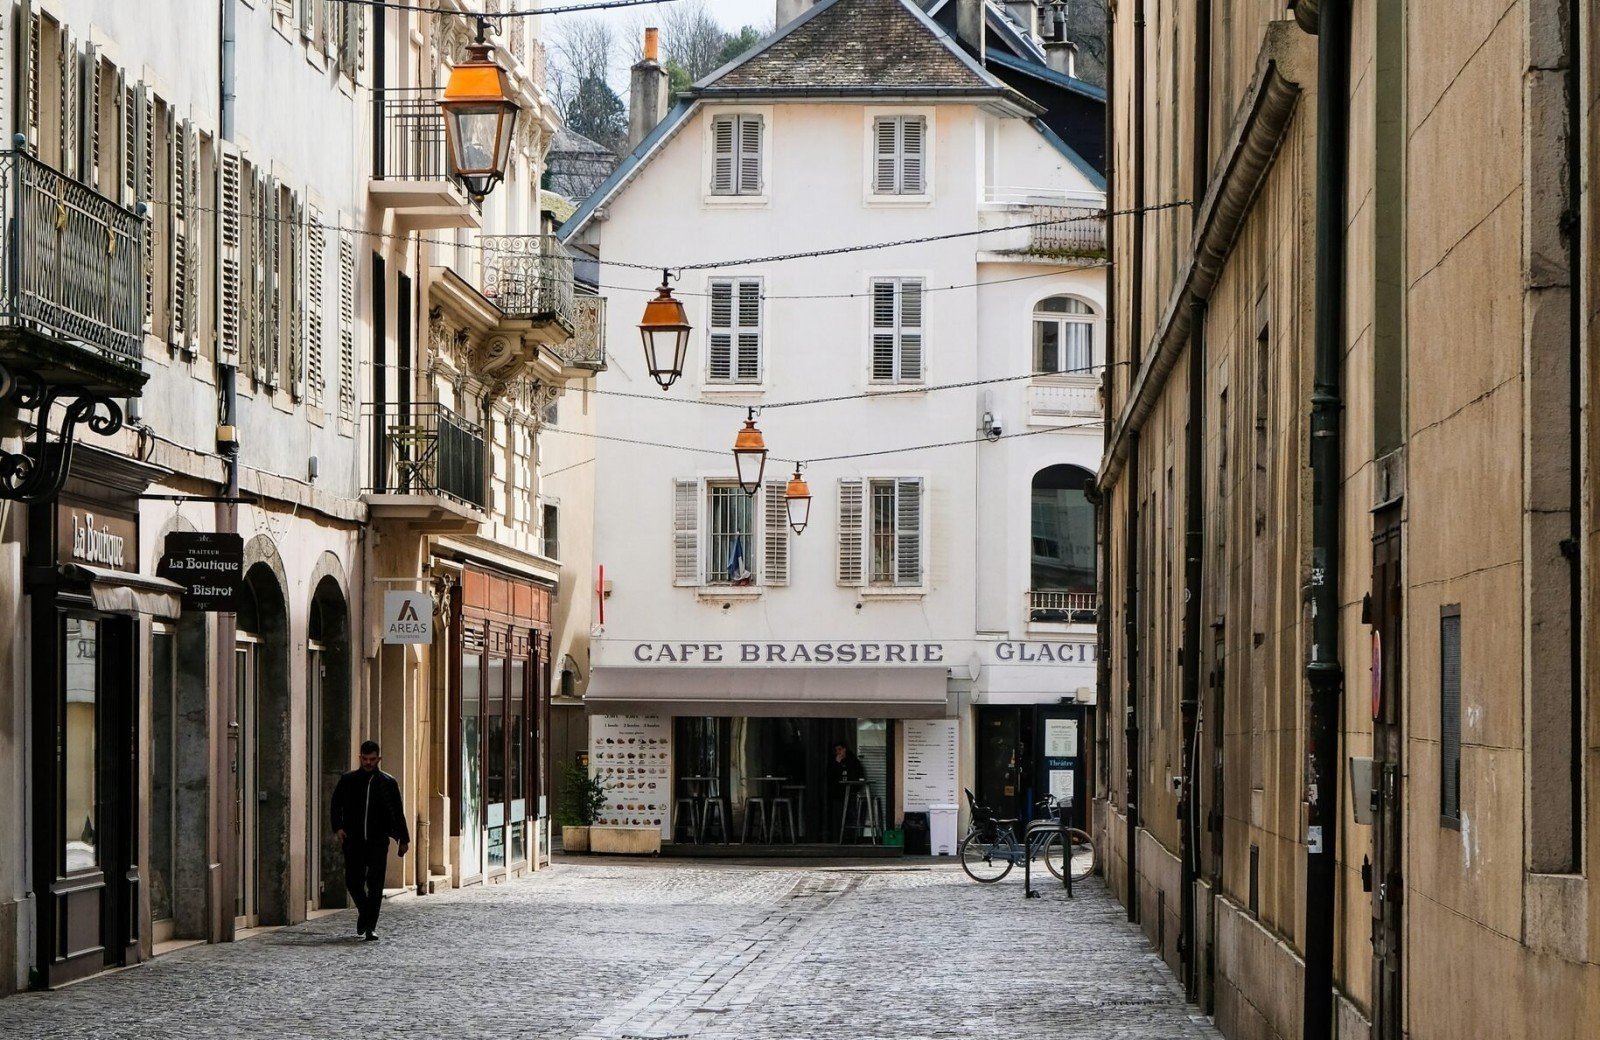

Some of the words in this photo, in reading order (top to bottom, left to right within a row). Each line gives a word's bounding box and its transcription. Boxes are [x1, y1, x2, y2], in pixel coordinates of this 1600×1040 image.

[73, 515, 85, 559] La
[86, 512, 125, 571] Boutique
[168, 558, 184, 569] La
[186, 557, 239, 572] Boutique
[192, 584, 233, 597] Bistrot
[389, 623, 427, 634] AREAS
[634, 643, 723, 662] CAFE
[740, 643, 943, 662] BRASSERIE
[996, 643, 1097, 663] GLACI
